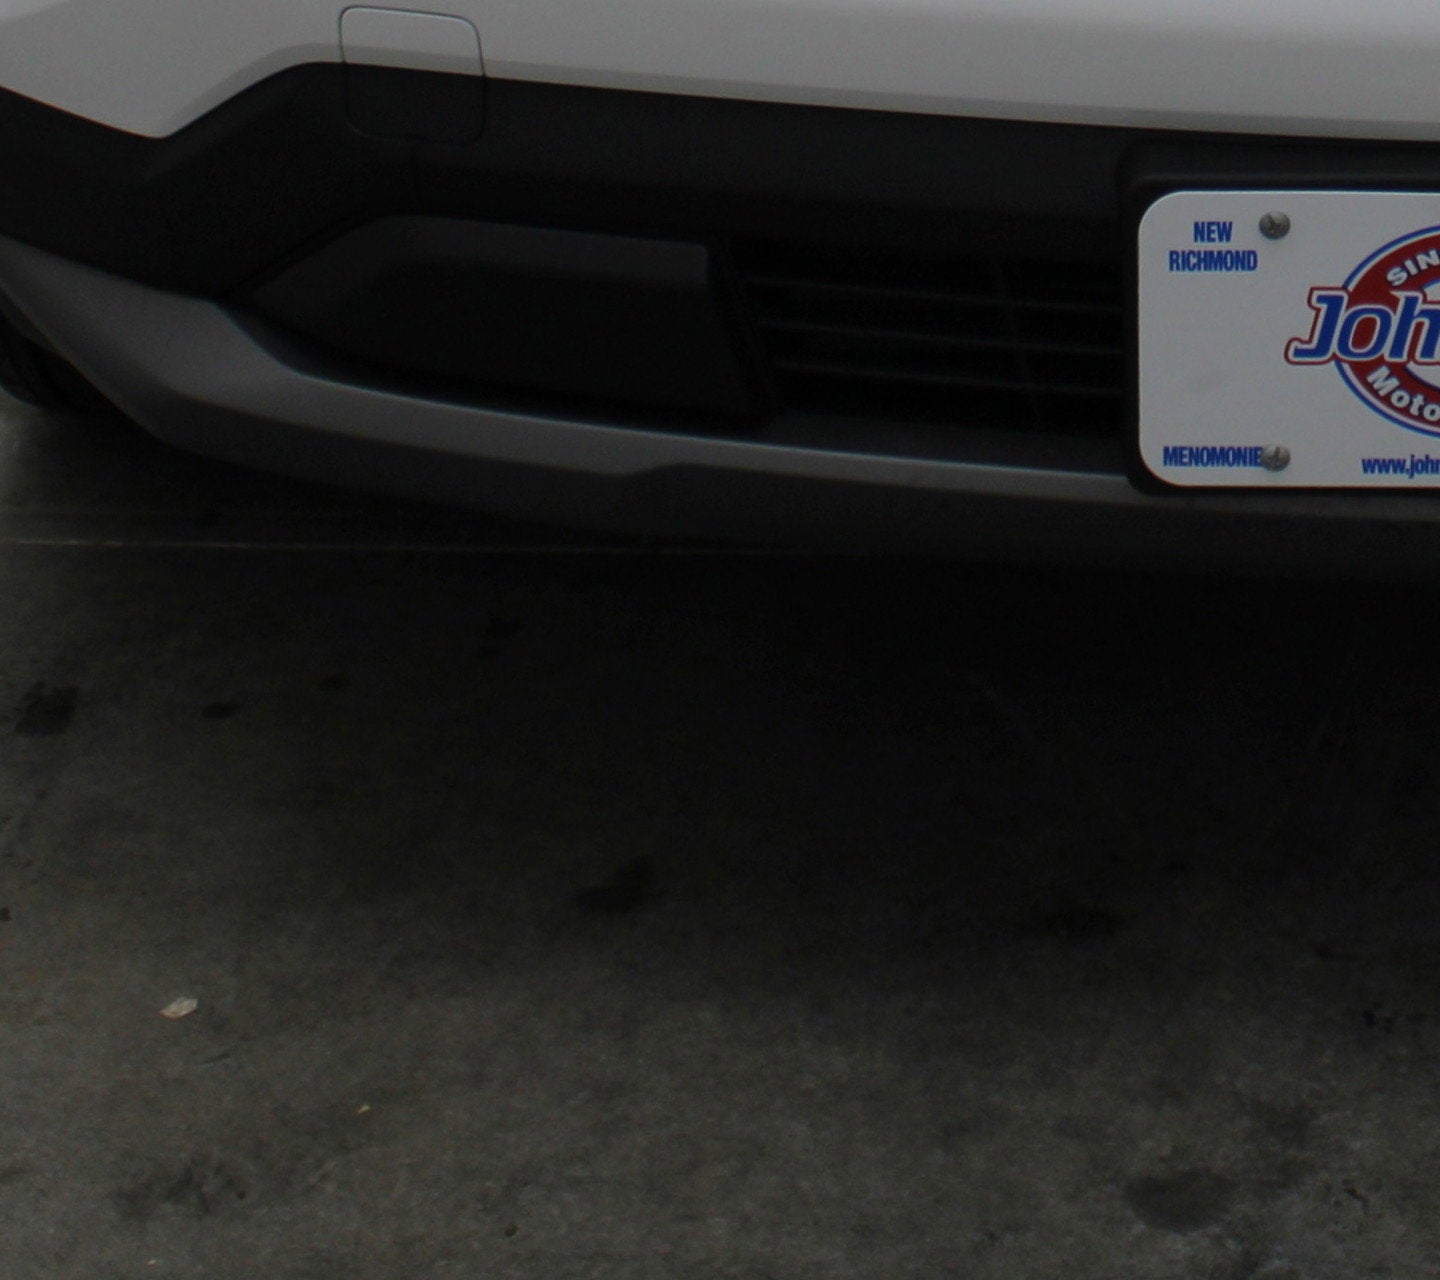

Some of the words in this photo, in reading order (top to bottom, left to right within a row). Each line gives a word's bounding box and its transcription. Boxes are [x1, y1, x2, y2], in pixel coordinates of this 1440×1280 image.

[1193, 221, 1233, 243] NEW
[1169, 250, 1259, 272] RICHMOND
[1163, 446, 1262, 468] MENOMONIE
